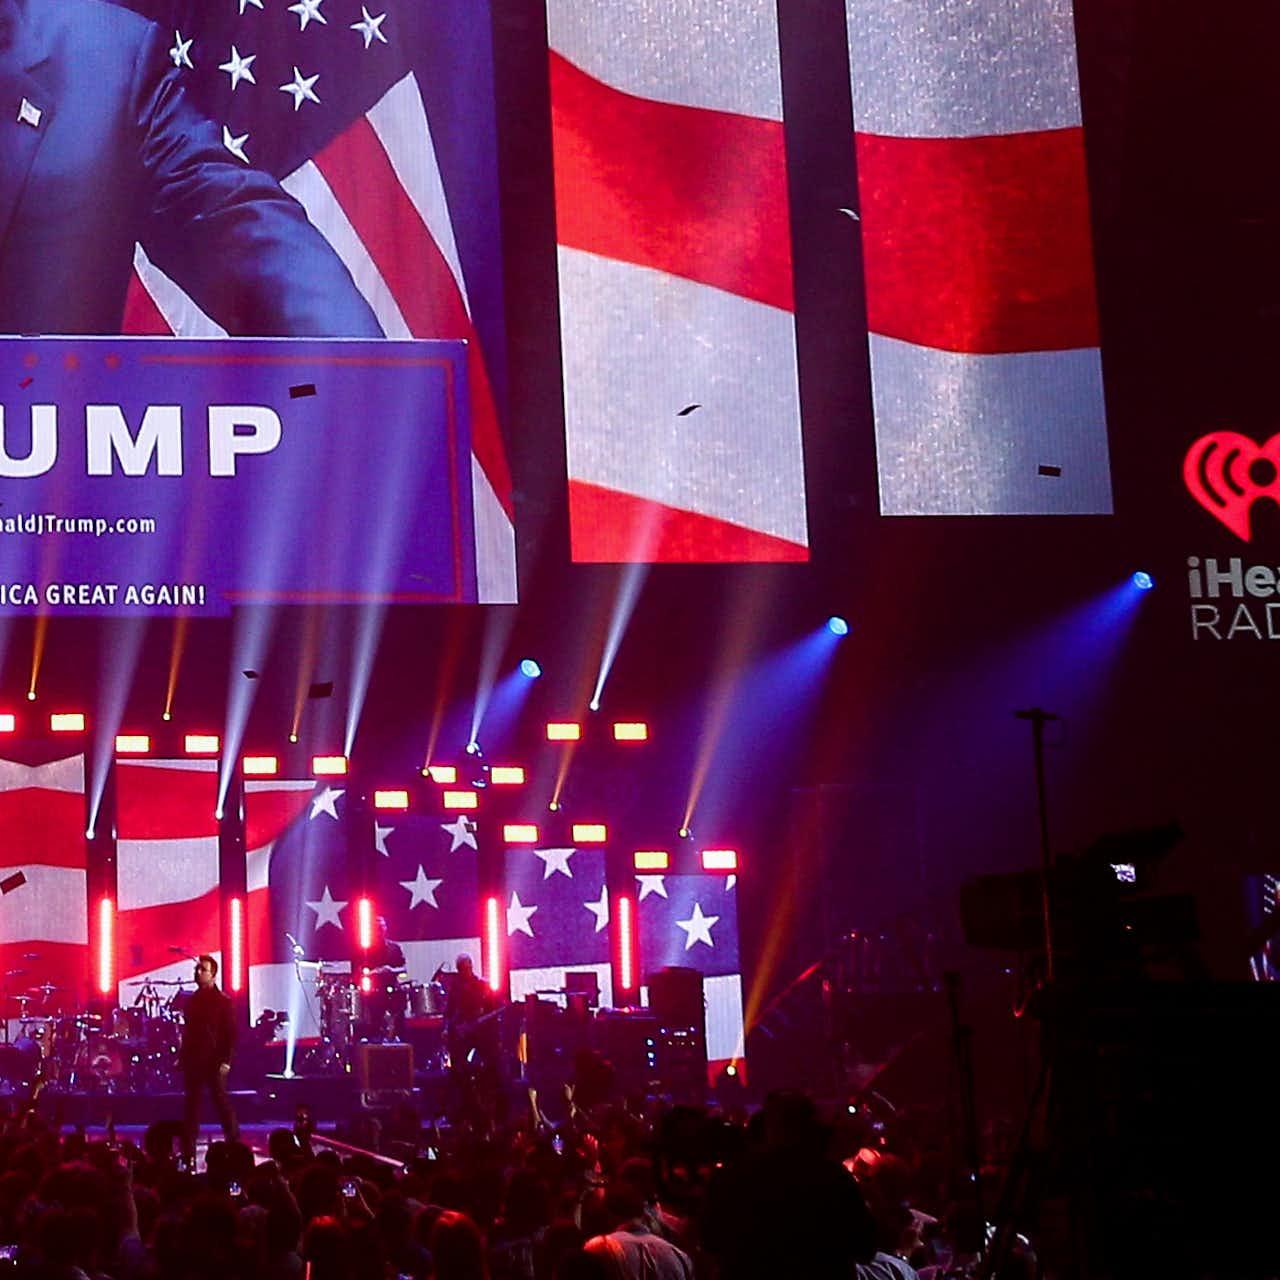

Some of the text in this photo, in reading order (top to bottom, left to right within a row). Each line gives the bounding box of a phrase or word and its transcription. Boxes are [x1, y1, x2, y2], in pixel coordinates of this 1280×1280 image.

[1187, 556, 1280, 597] iHe
[46, 584, 118, 605] GREAT
[124, 584, 206, 605] AGAIN!
